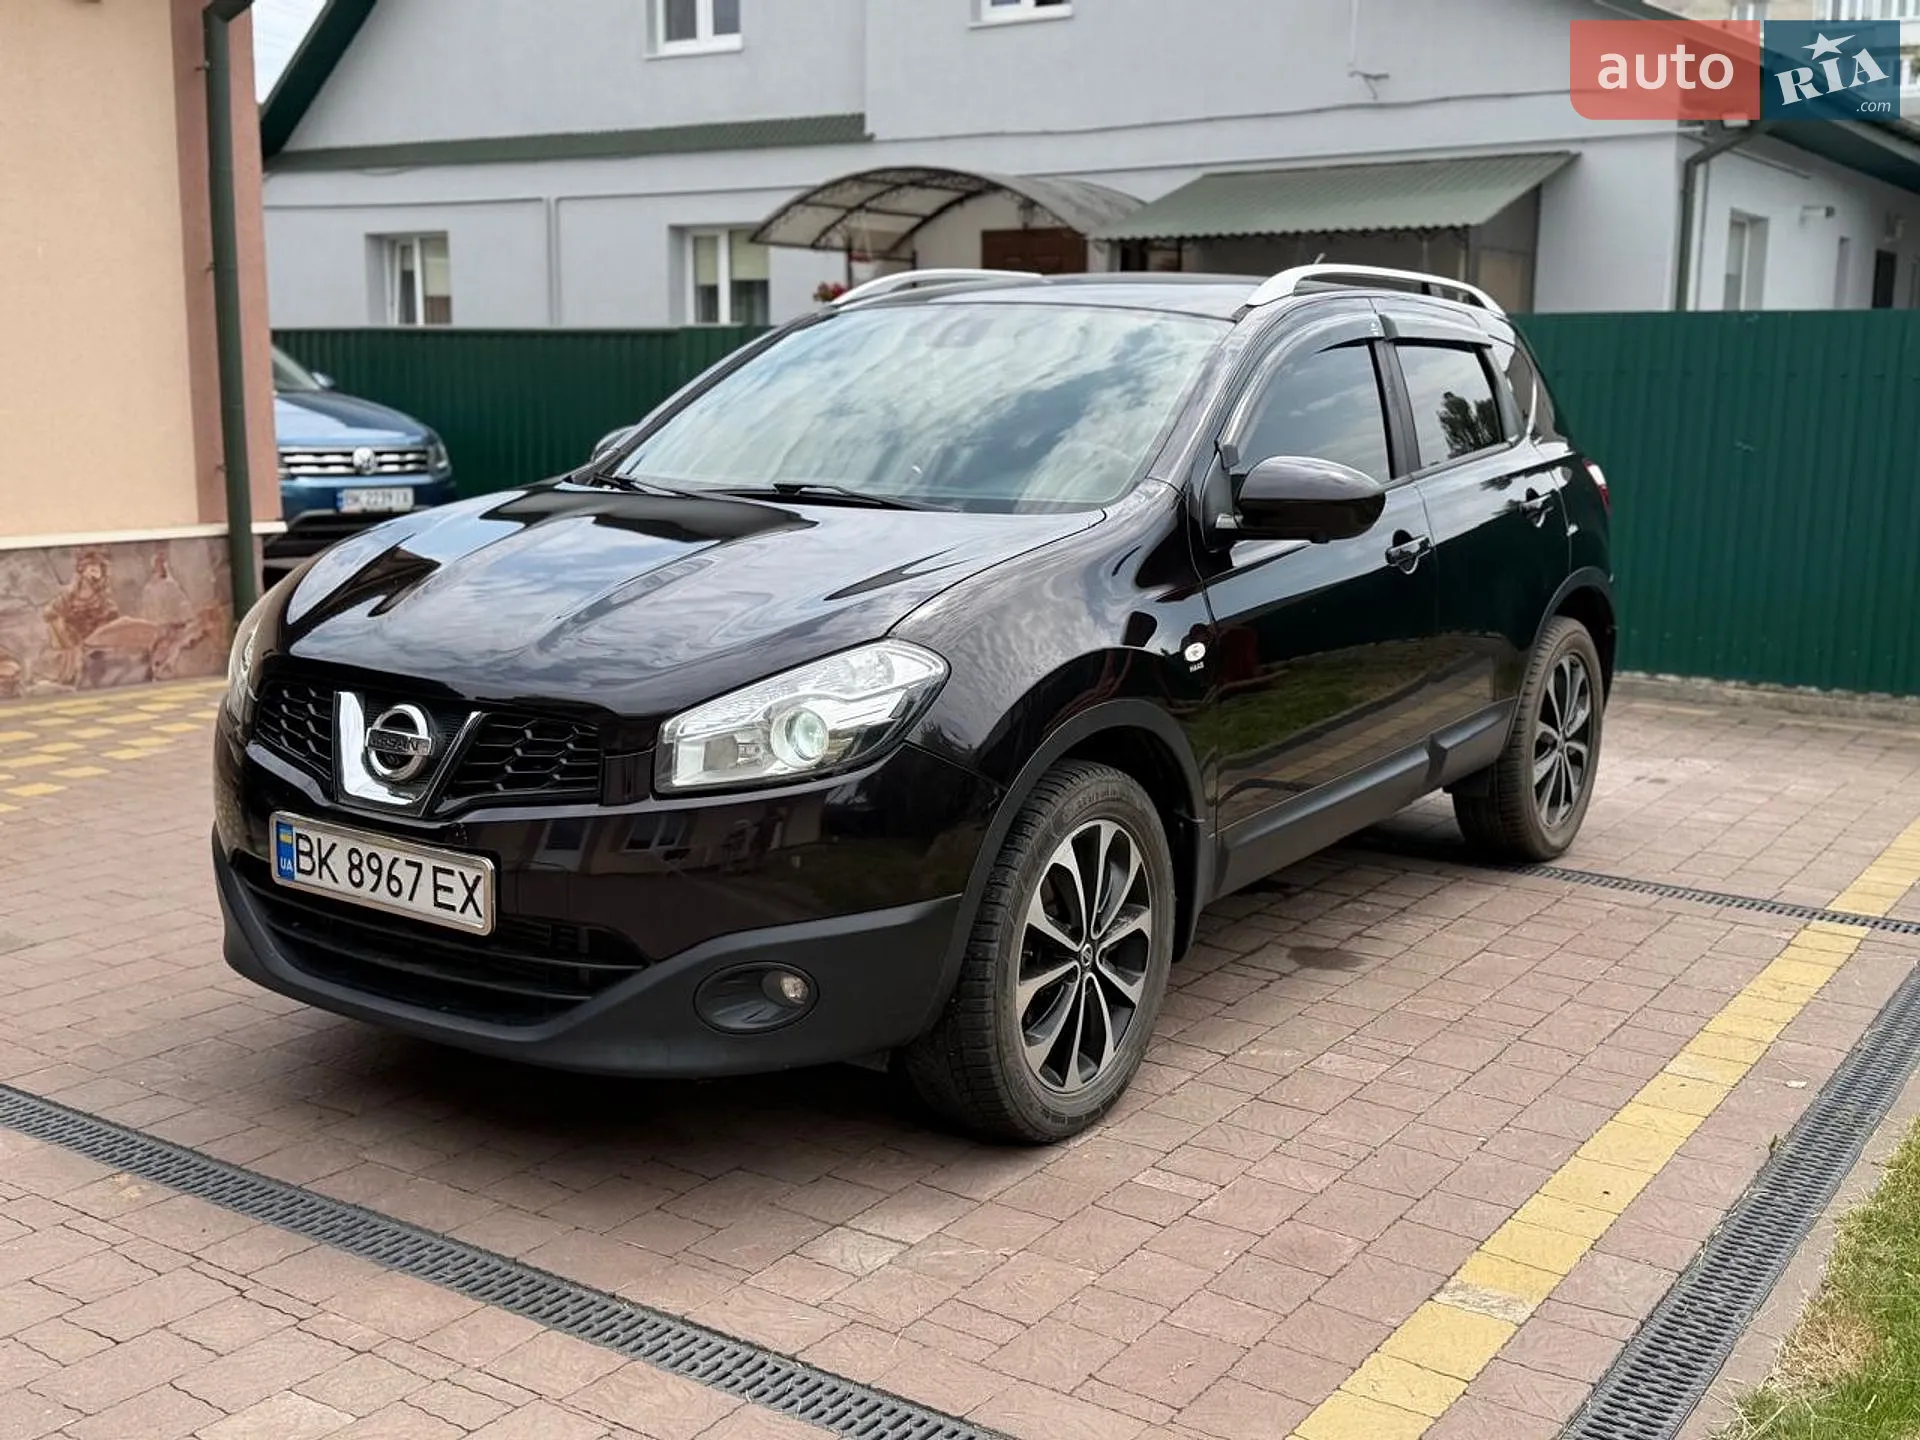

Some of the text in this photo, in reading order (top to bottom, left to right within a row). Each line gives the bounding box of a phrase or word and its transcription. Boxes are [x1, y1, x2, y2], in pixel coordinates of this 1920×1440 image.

[280, 857, 293, 872] UA
[295, 833, 482, 918] BK 8967 EX
